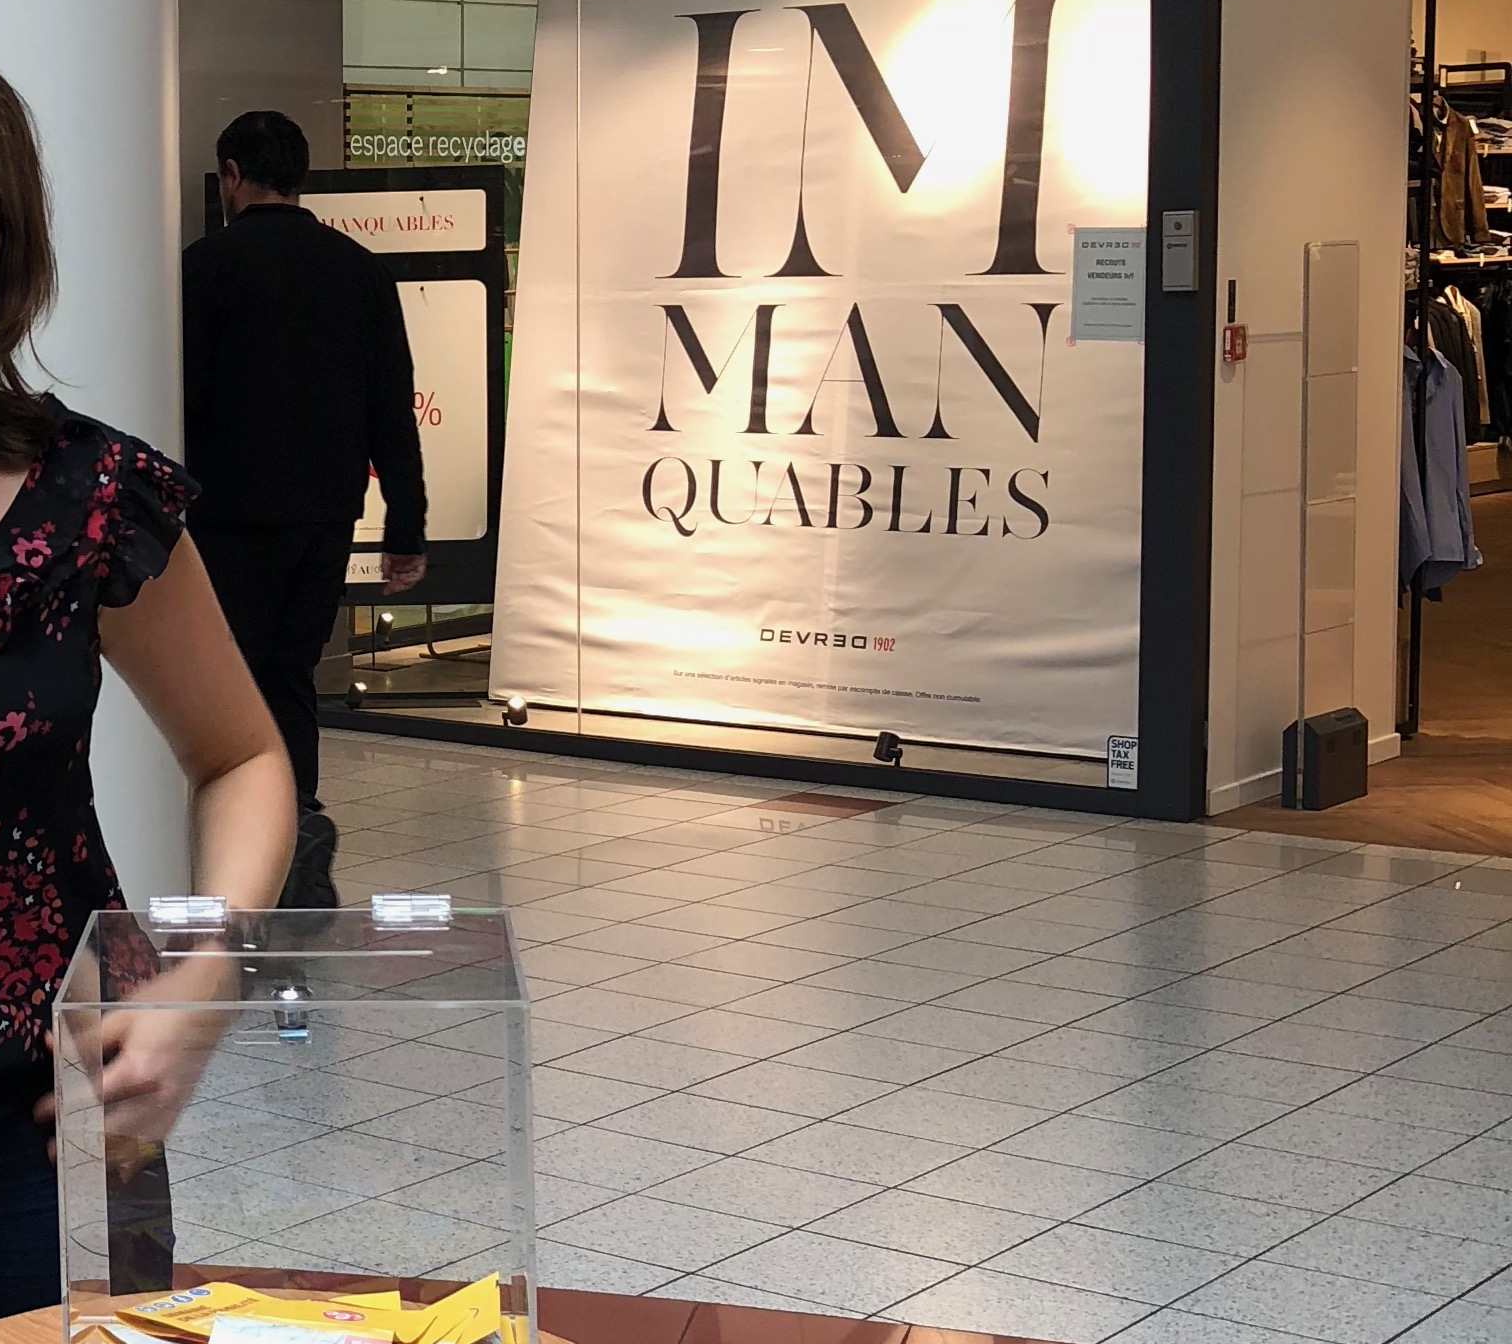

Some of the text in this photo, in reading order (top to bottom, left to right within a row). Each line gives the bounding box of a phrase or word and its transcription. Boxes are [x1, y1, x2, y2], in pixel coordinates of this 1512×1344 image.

[350, 131, 526, 166] espace recyclage
[646, 302, 1063, 445] MAN
[642, 456, 1052, 542] QUABLES
[873, 637, 895, 652] 1902
[1111, 739, 1137, 749] SHOP
[1111, 749, 1129, 759] TAX
[1111, 760, 1134, 770] FREE
